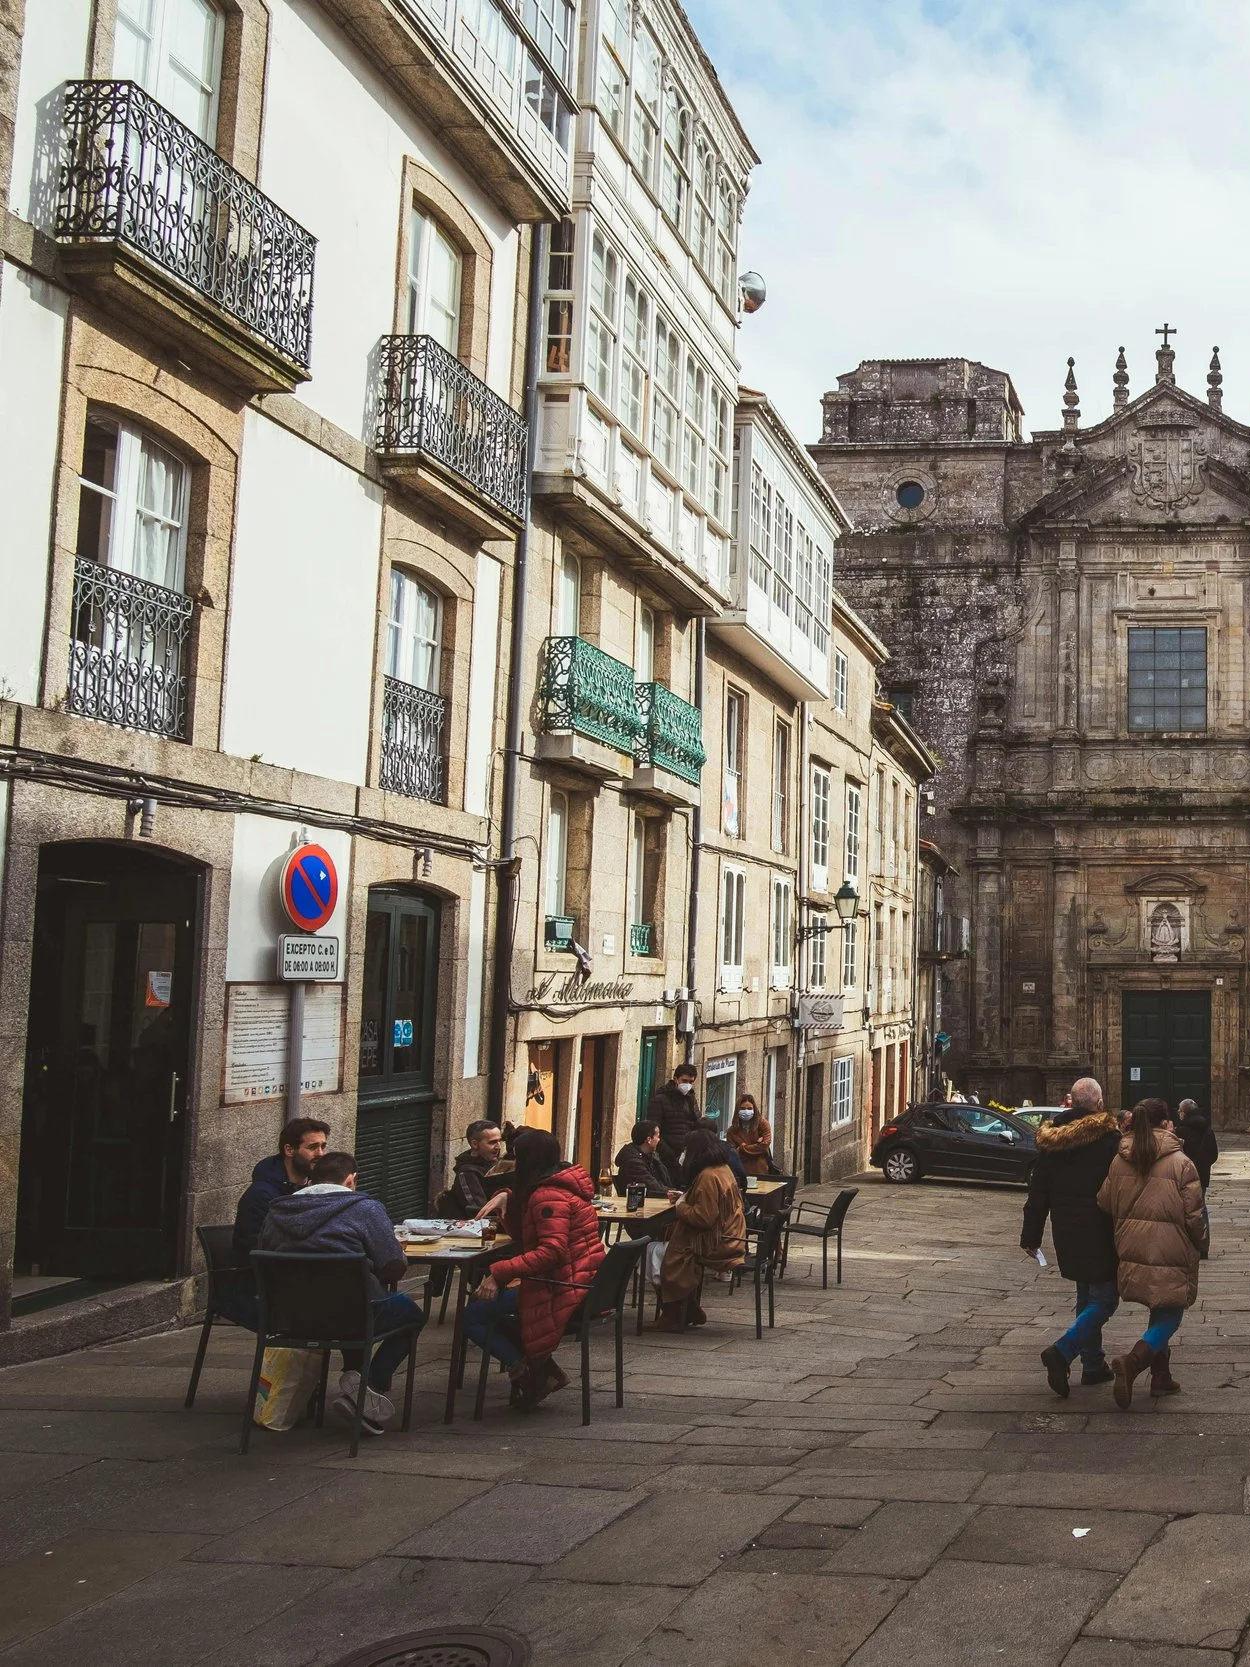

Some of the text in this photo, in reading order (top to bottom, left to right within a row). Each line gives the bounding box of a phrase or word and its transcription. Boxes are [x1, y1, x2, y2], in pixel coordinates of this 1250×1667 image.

[286, 942, 316, 955] EXCEPTO
[325, 947, 328, 955] e
[285, 960, 291, 972] DE
[310, 960, 314, 972] A
